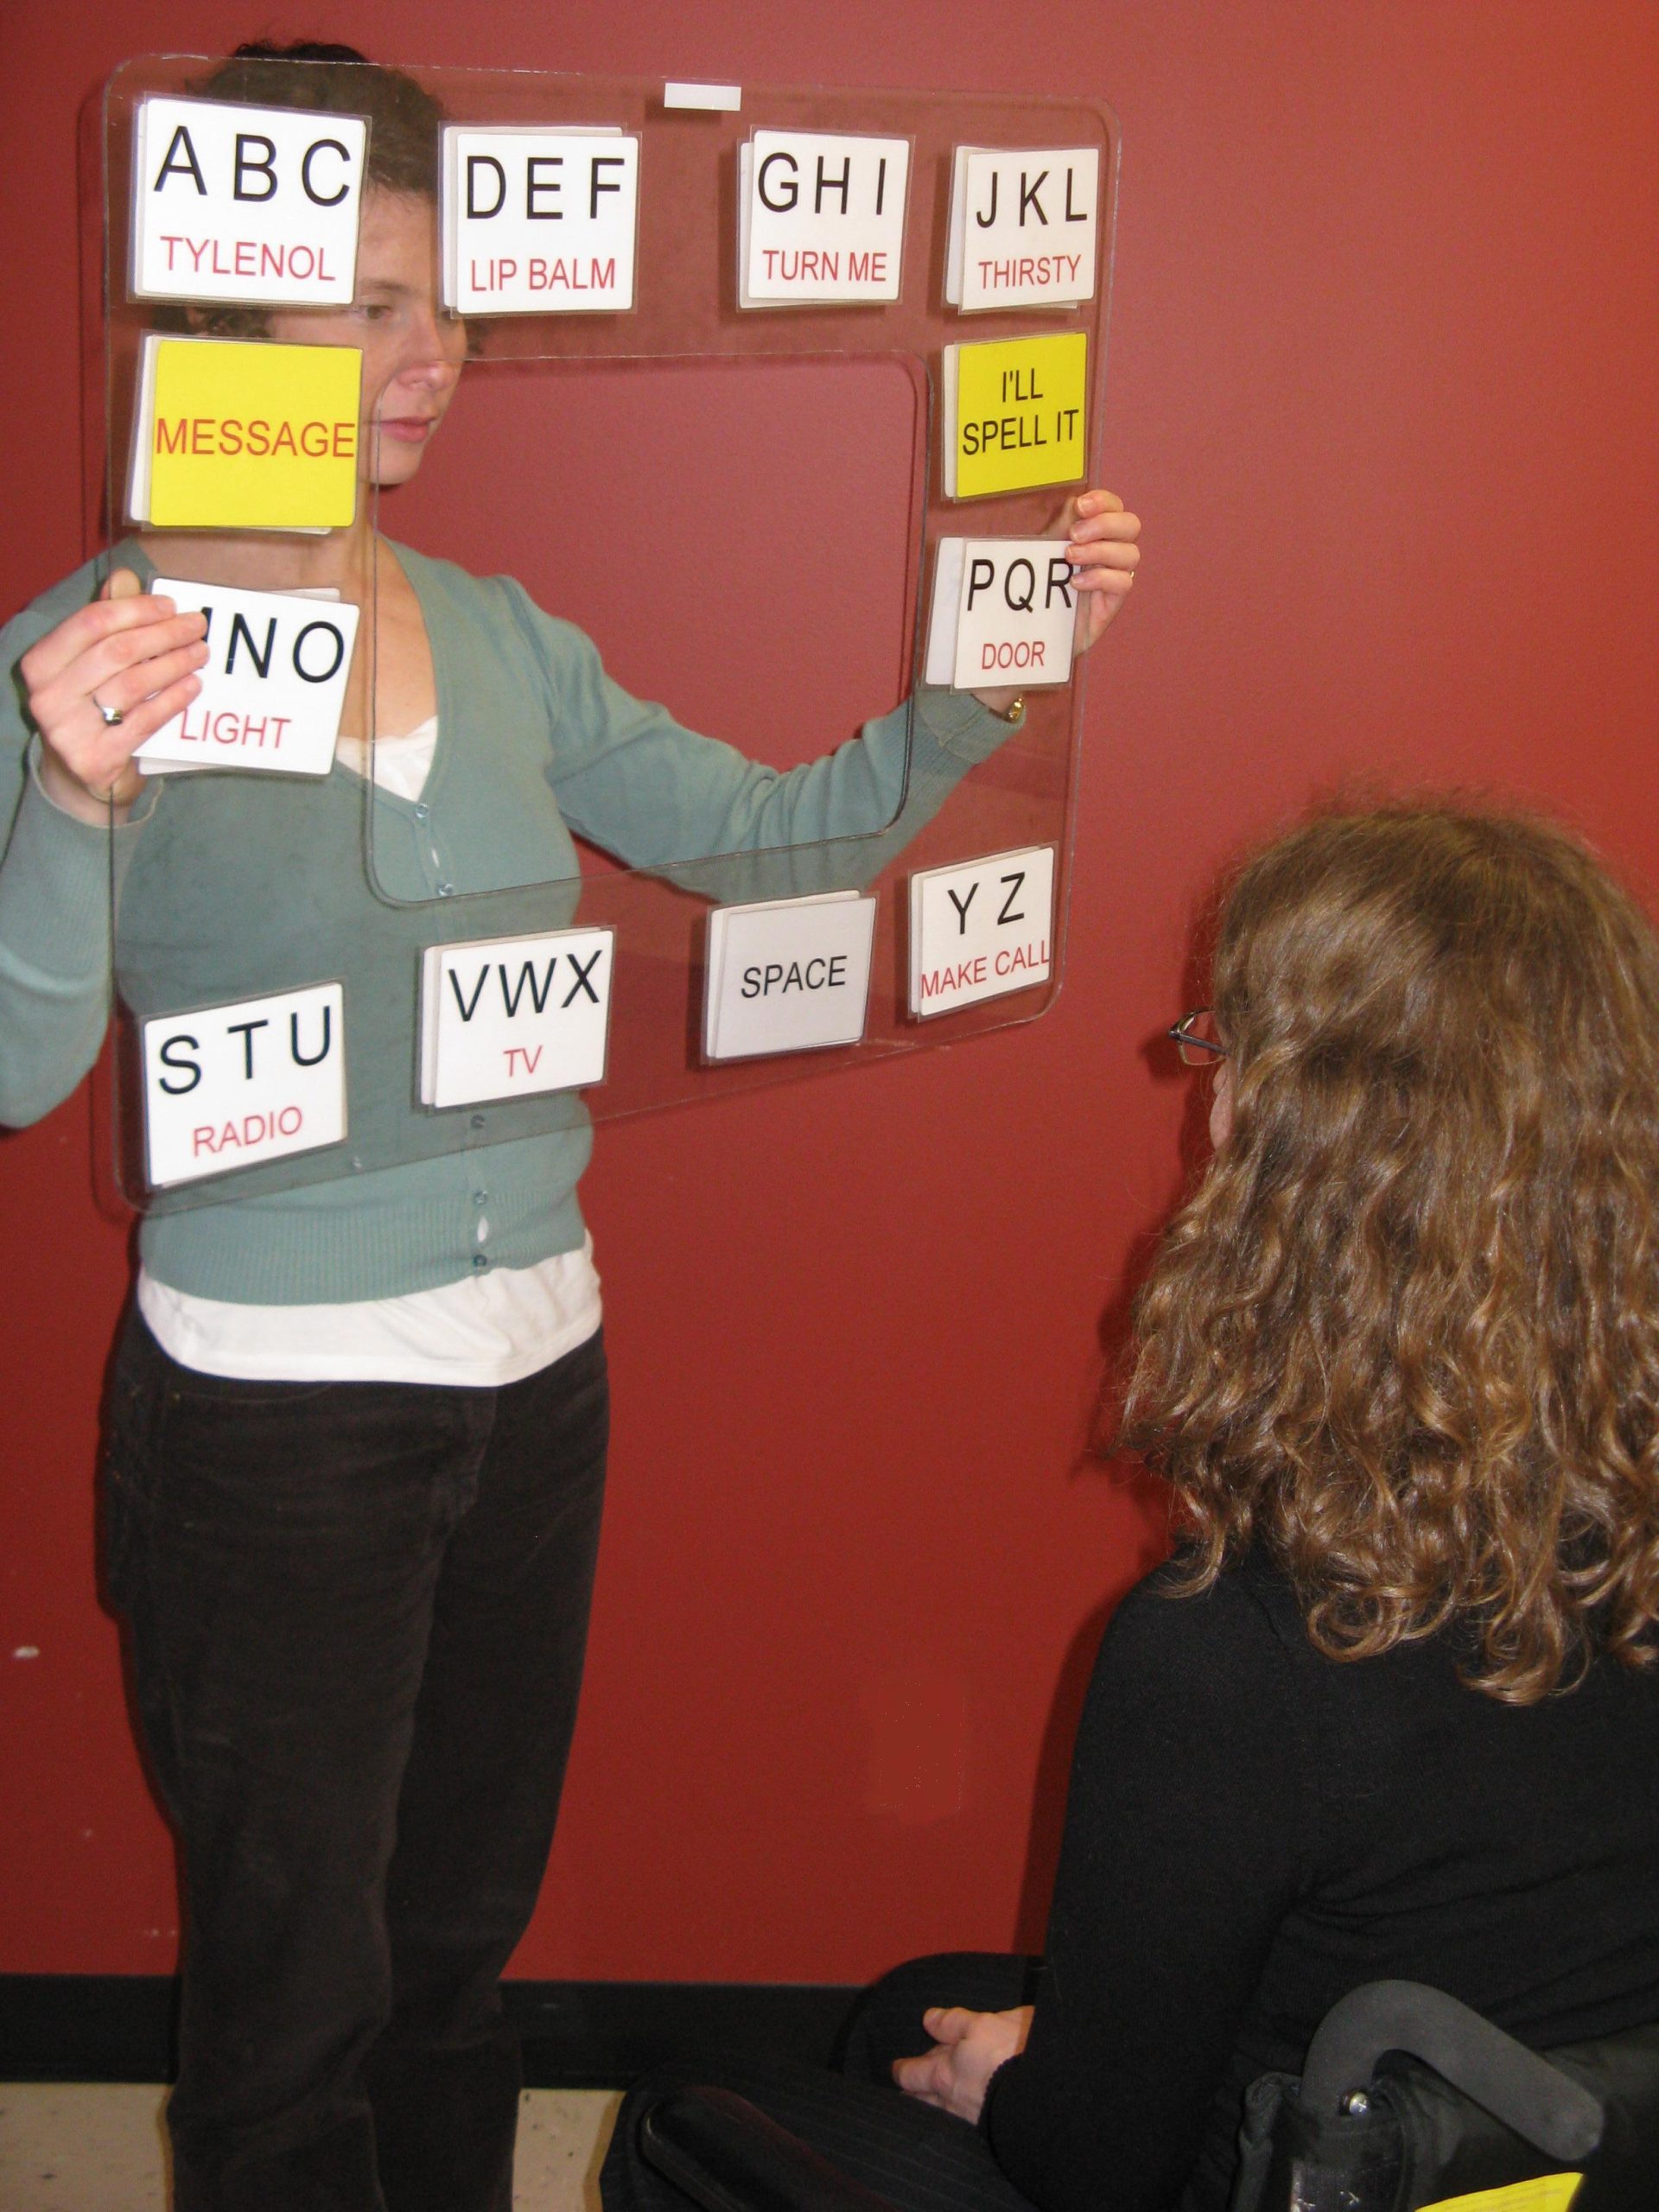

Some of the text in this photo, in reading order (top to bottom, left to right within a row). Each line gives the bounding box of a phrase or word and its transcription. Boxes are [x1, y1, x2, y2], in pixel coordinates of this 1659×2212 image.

[161, 236, 335, 281] TYLENOL
[472, 258, 615, 291] LIP BALM
[763, 250, 887, 282] TURN ME
[978, 255, 1081, 289] THIRSTY
[1002, 368, 1043, 402] I'LL
[156, 419, 355, 457] MESSAGE
[963, 410, 1078, 455] SPELL IT
[982, 641, 1045, 670] DOOR
[180, 708, 292, 748] LIGHT
[741, 956, 847, 998] SPACE
[921, 939, 1050, 999] MAKE CALL
[504, 1046, 542, 1077] TV
[193, 1106, 302, 1157] RADIO
